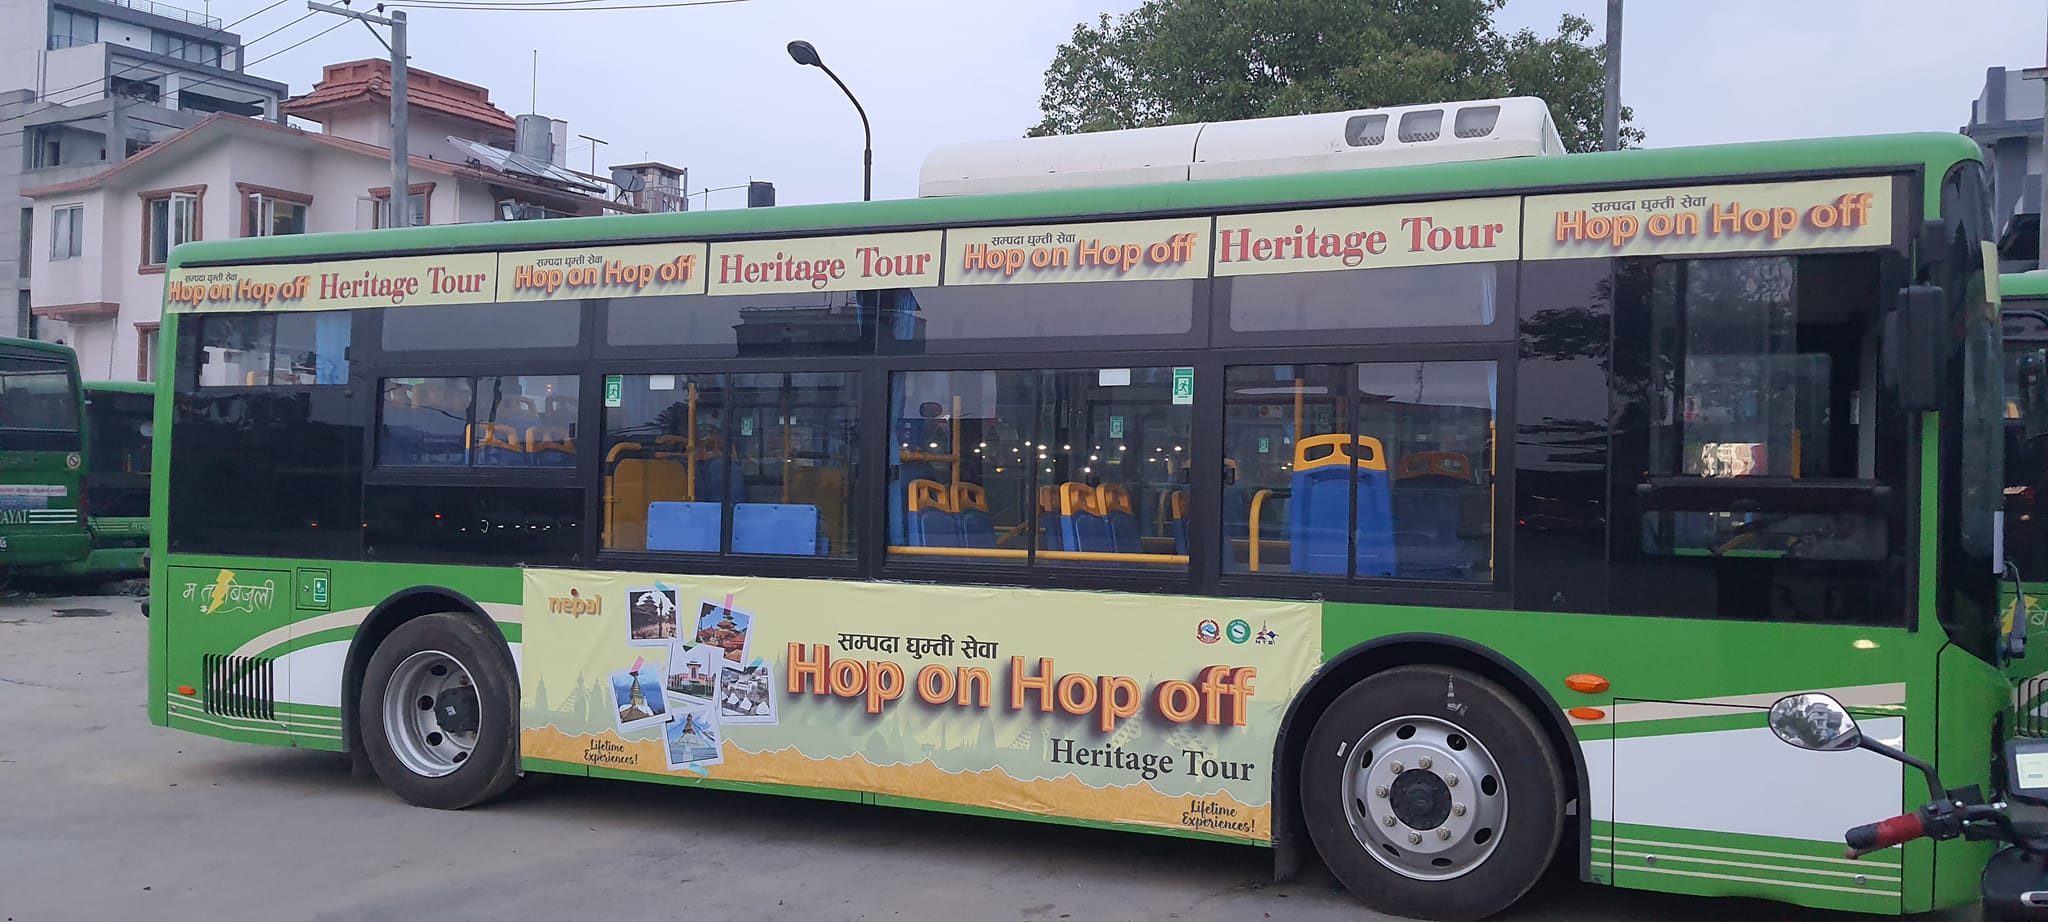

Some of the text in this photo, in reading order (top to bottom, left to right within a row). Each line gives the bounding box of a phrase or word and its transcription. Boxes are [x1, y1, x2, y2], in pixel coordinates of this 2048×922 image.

[1591, 194, 1707, 213] सम्पदा घुम्ती सेवा
[1555, 192, 1873, 247] Hop on Hop off
[991, 232, 1076, 247] सम्पदा घुम्ती सेवा
[1218, 217, 1503, 266] Heritage Tour
[536, 254, 603, 268] सम्पदा घुम्ती सेवा
[718, 247, 931, 289] Heritage Tour
[964, 232, 1197, 276] Hop on Hop off
[319, 266, 486, 304] Heritage Tour
[515, 255, 696, 294] Hop on Hop off
[168, 275, 311, 306] Hop on Hop off
[548, 593, 602, 618] nepal
[837, 633, 999, 659] सम्पदा घुम्ती सेवा
[787, 641, 1257, 733] Hop on Hop off
[584, 749, 638, 765] Experiences!
[591, 739, 624, 753] Lifetime
[1051, 738, 1255, 781] Heritage Tour
[1182, 812, 1255, 832] Experiences!
[1190, 800, 1237, 818] Lifetime
